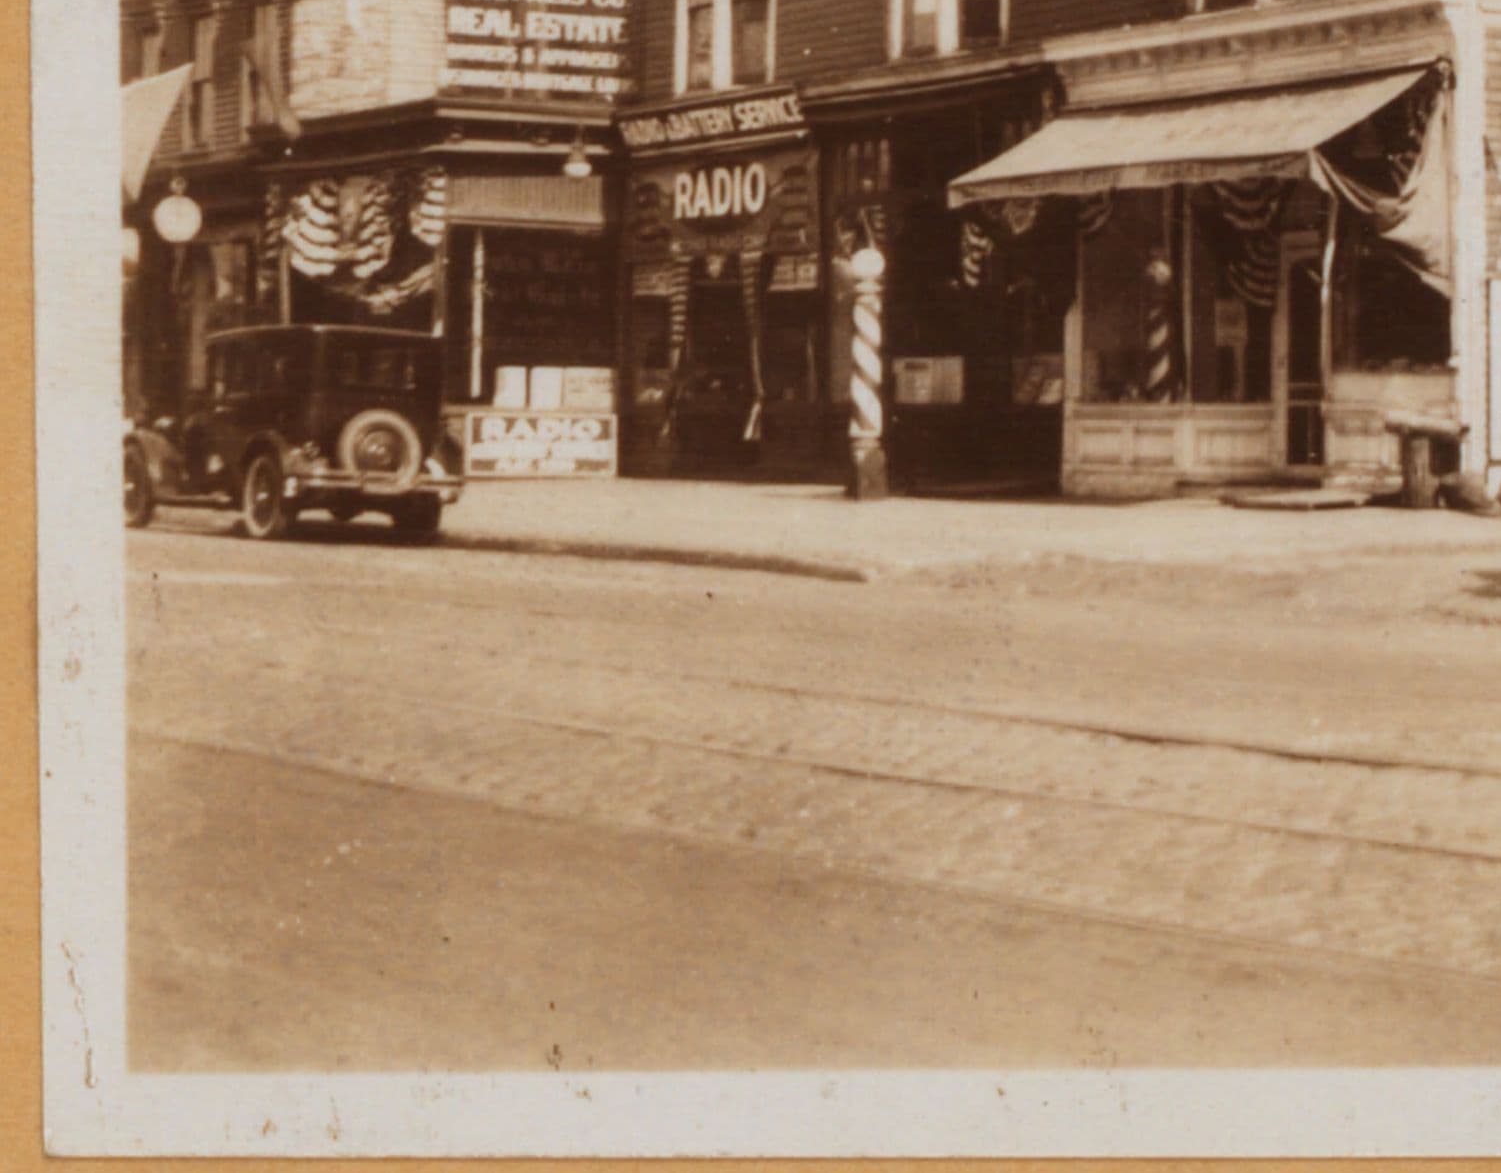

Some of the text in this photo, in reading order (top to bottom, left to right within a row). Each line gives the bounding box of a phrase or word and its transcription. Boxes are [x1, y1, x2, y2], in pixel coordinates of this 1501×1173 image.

[447, 5, 629, 44] REAL ESTATE
[734, 94, 805, 131] SERVICE
[673, 162, 766, 220] RADIO
